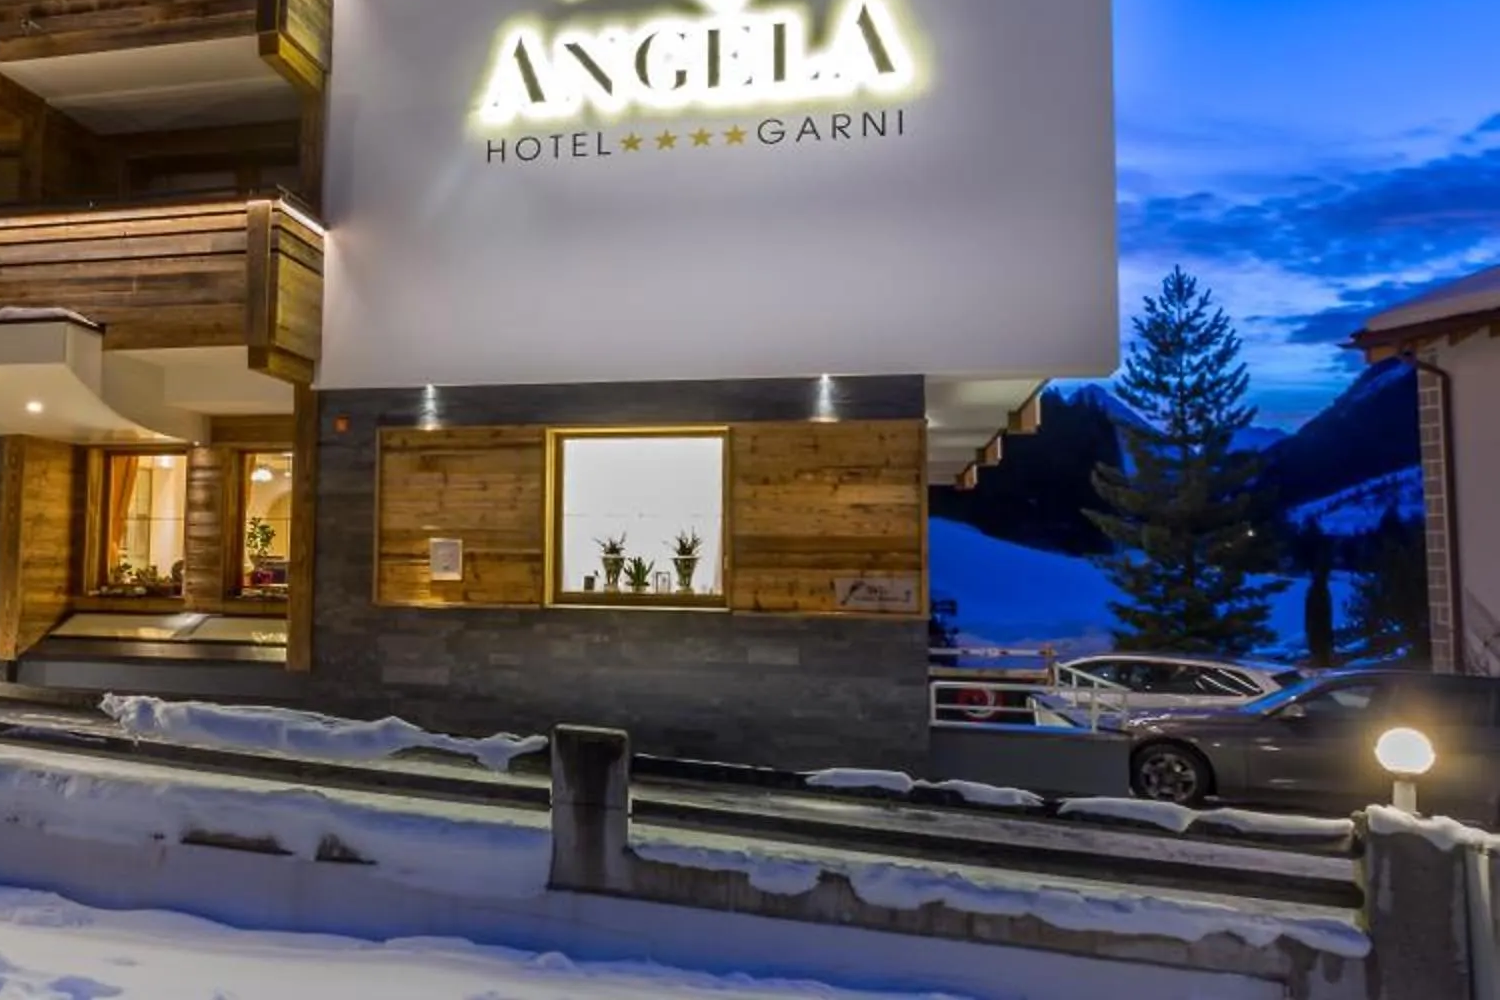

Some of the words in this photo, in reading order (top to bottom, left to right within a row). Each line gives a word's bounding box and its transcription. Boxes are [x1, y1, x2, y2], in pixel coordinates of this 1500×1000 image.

[486, 1, 897, 109] ANGELA
[486, 131, 613, 165] HOTEL
[757, 108, 904, 146] GARNI
